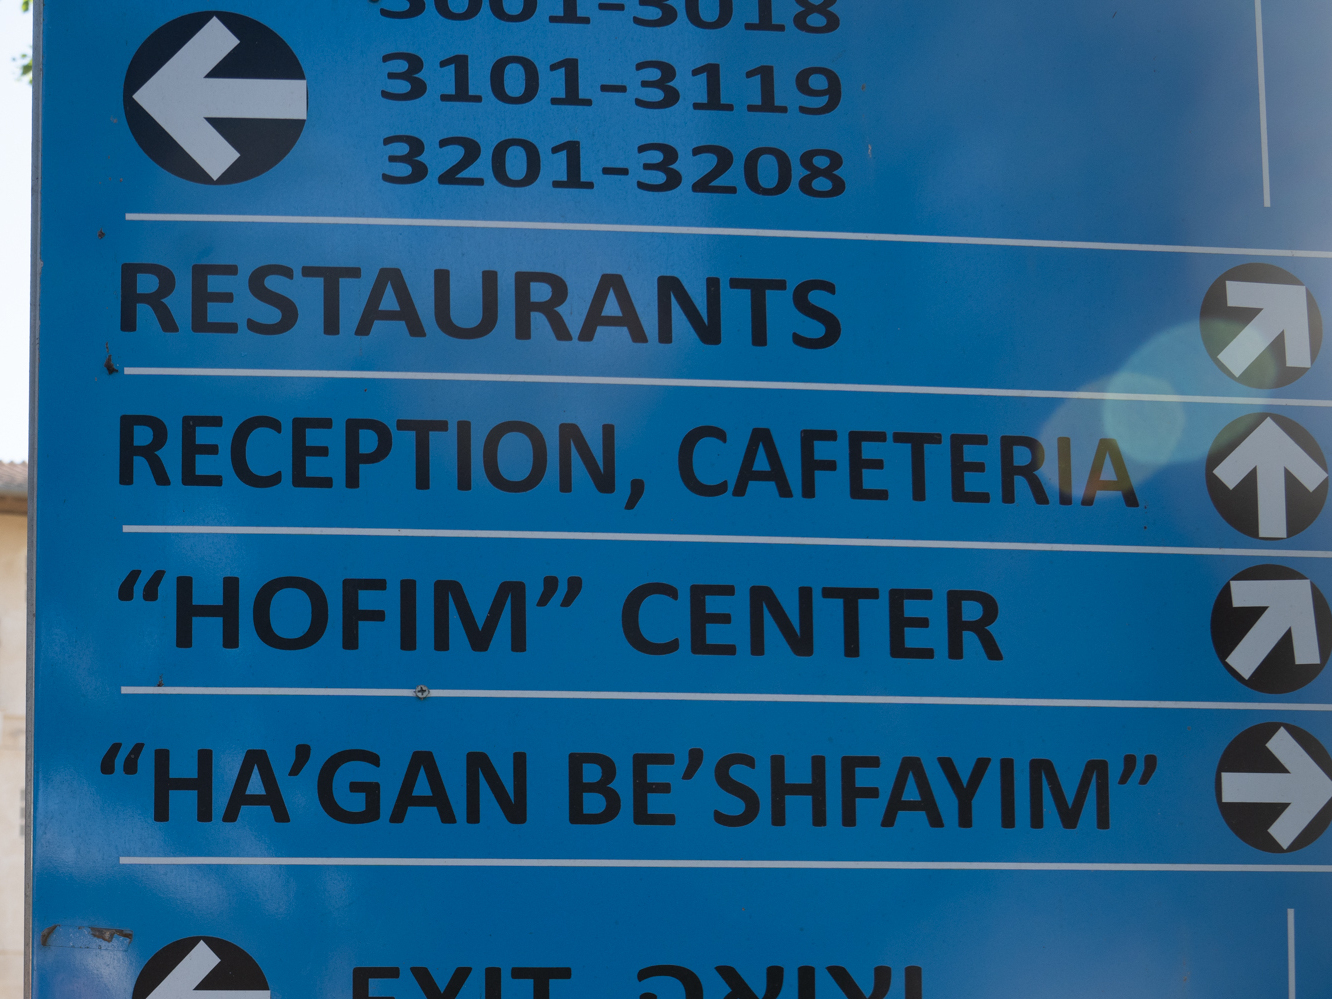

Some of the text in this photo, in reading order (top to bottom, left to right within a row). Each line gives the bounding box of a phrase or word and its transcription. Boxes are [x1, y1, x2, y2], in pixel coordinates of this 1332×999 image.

[380, 51, 843, 116] 3101-3119
[381, 134, 847, 199] 3201-3208
[119, 262, 842, 350] RESTAURANTS
[118, 413, 1141, 511] RECEPTION, CAFETERIA
[117, 568, 1004, 662] “HOFIM” CENTER
[99, 741, 1158, 832] “HA’GAN BE’SHFAYIM”
